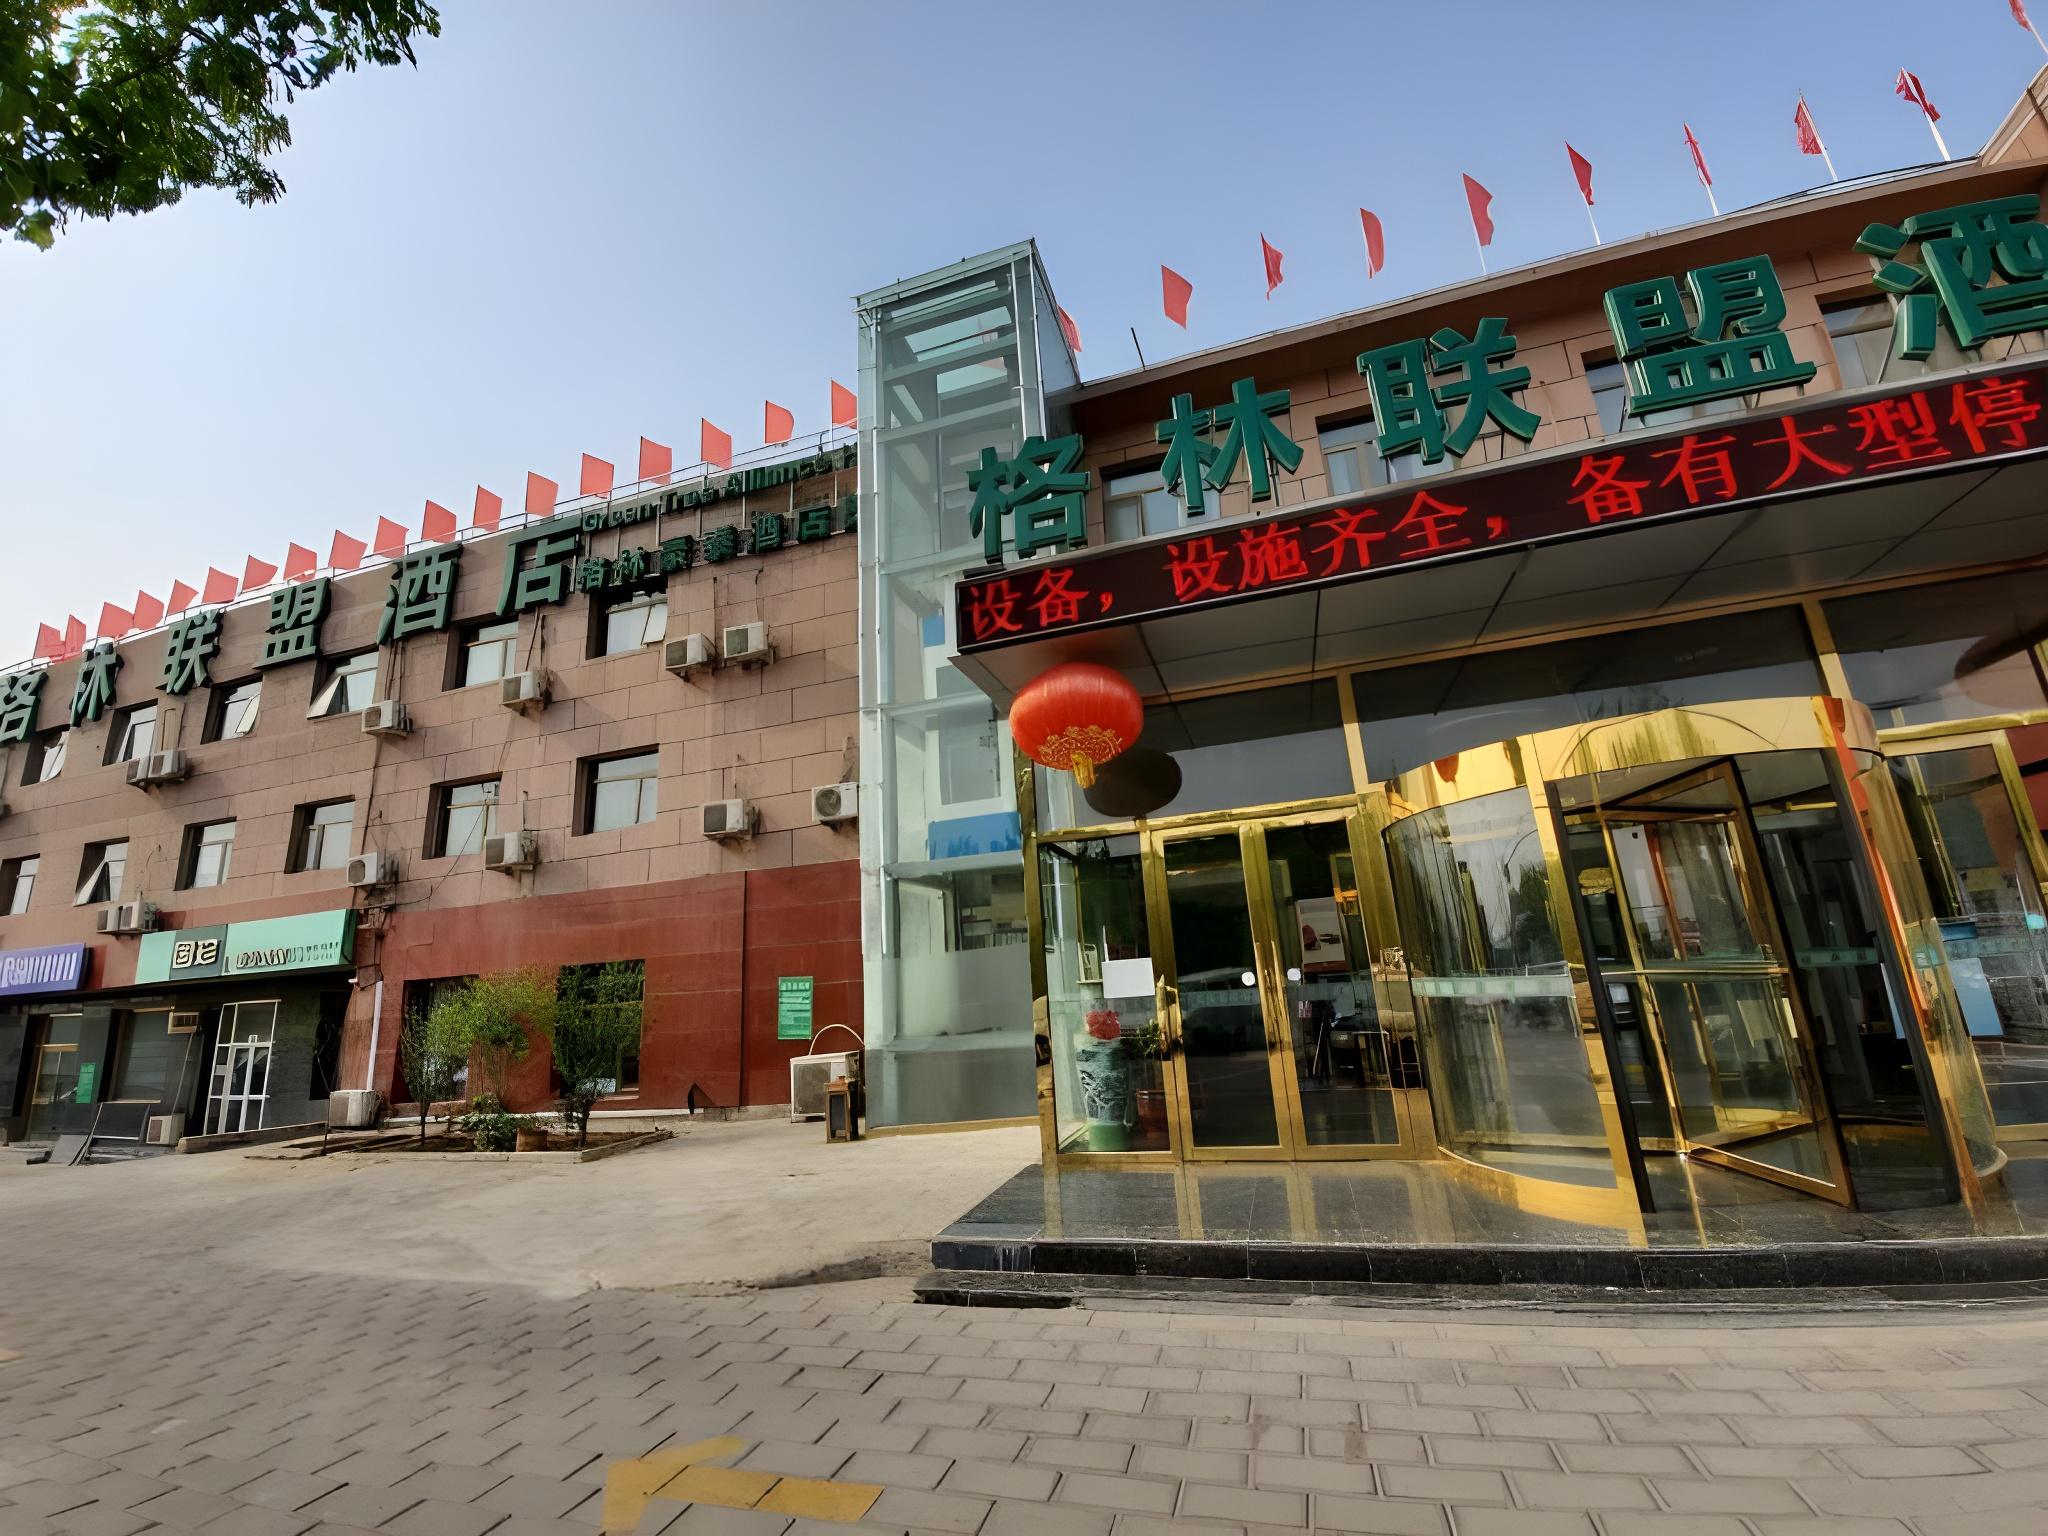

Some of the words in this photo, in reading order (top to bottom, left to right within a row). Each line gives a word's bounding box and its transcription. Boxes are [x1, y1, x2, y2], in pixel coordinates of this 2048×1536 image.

[968, 193, 2048, 565] 格林联盟酒
